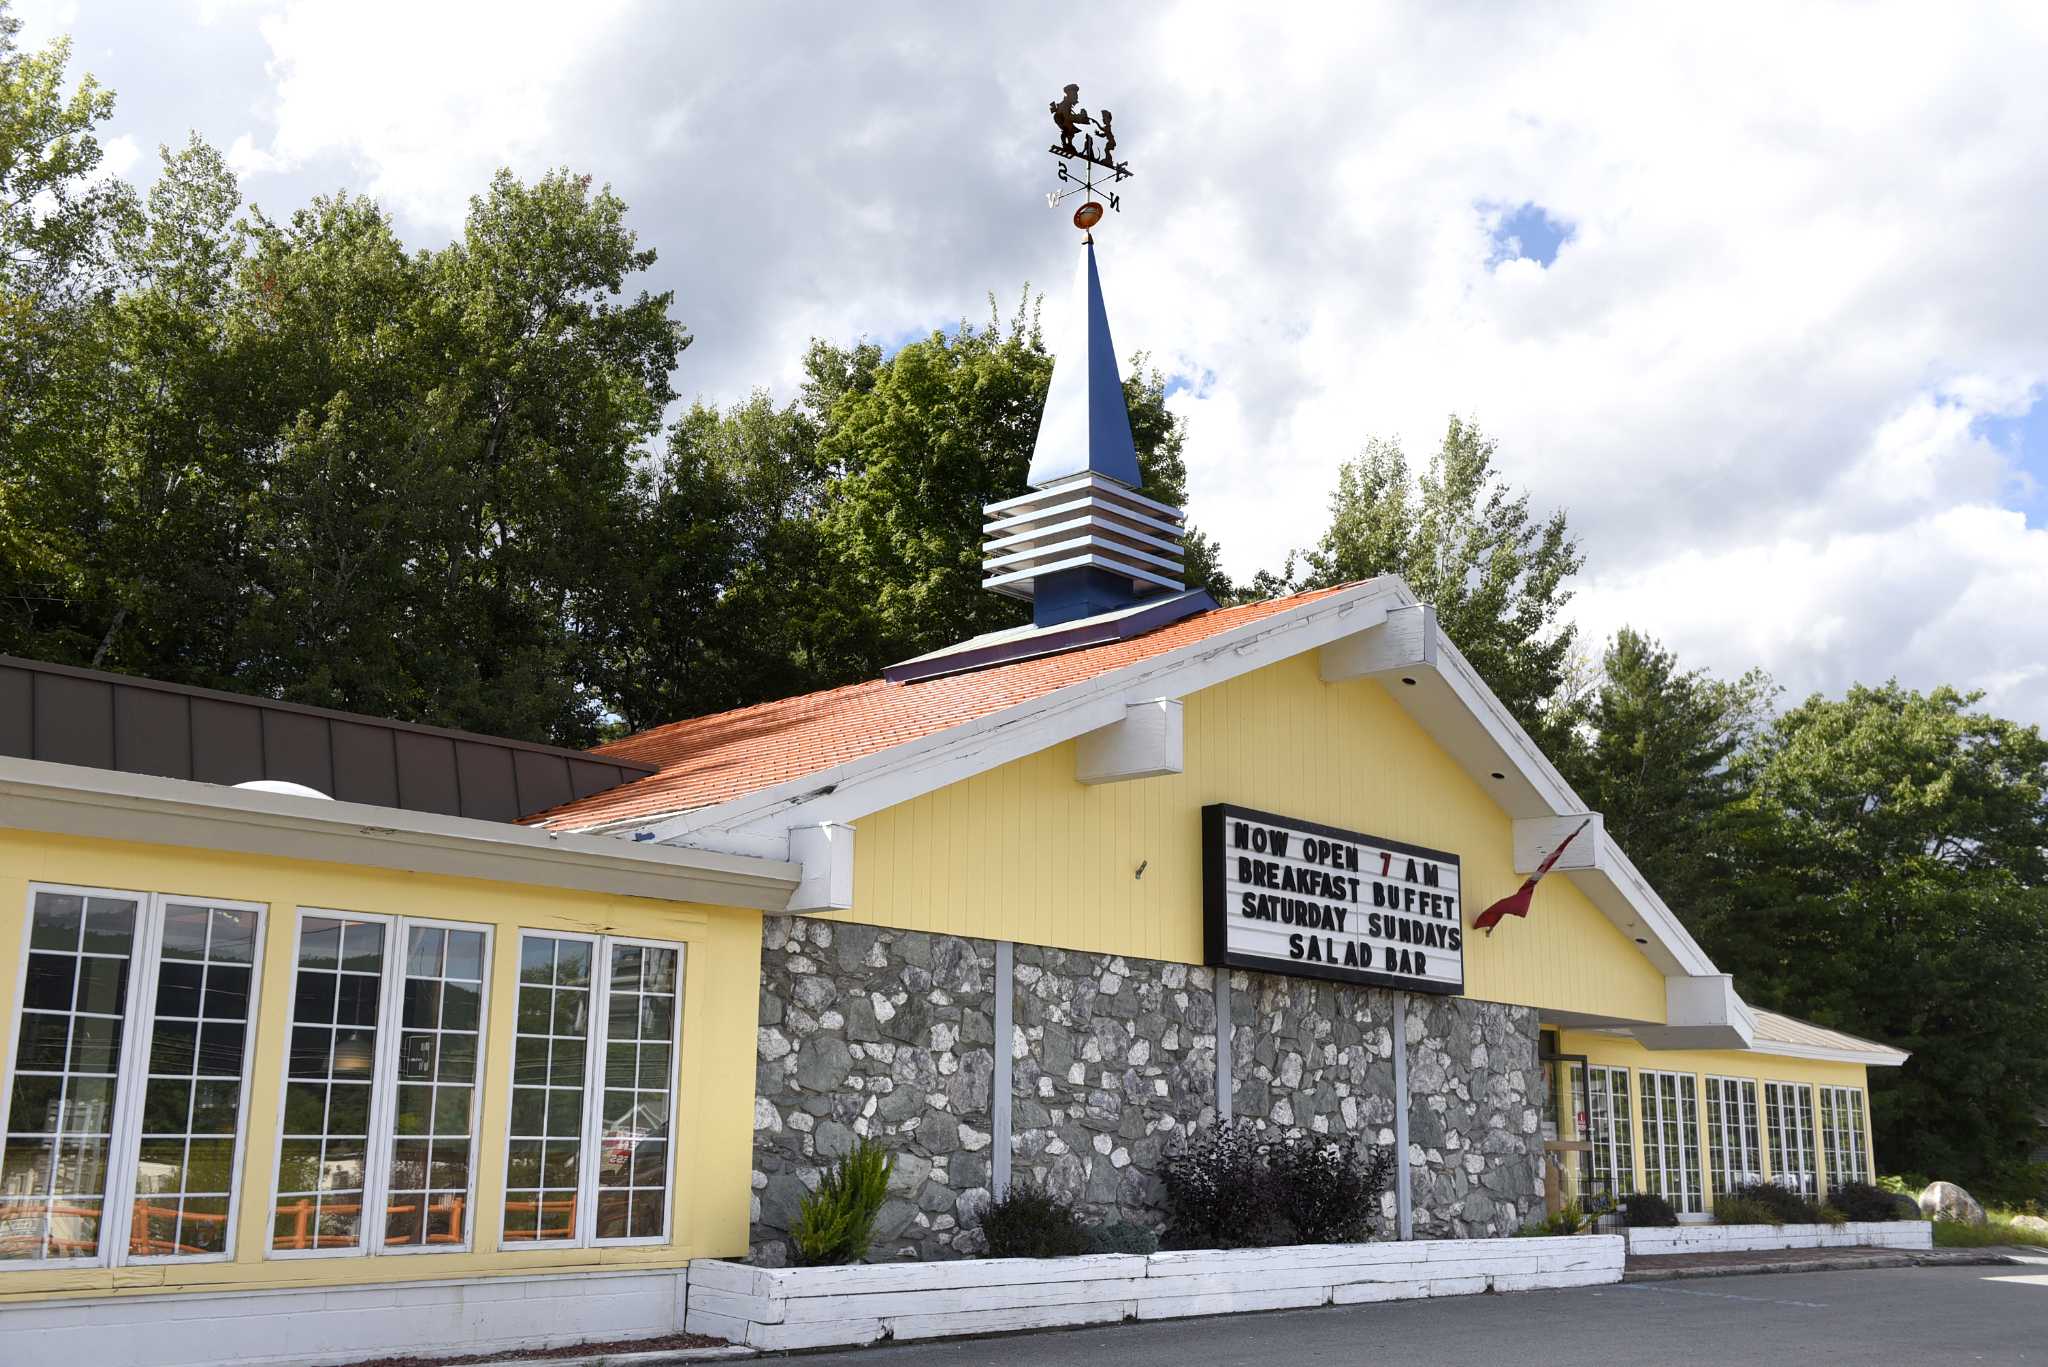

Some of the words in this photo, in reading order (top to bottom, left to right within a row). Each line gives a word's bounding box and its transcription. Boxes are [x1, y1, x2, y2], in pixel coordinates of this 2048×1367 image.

[1235, 821, 1288, 857] NOW
[1303, 837, 1359, 873] OPEN
[1380, 852, 1391, 877] 7
[1405, 858, 1439, 888] AM
[1238, 856, 1360, 904] BREAKFAST
[1373, 881, 1454, 920] BUFFET
[1242, 892, 1347, 933] SATURDAY
[1368, 912, 1461, 951] SUNDAYS
[1289, 933, 1372, 968] SALAD
[1386, 946, 1427, 975] BAR
